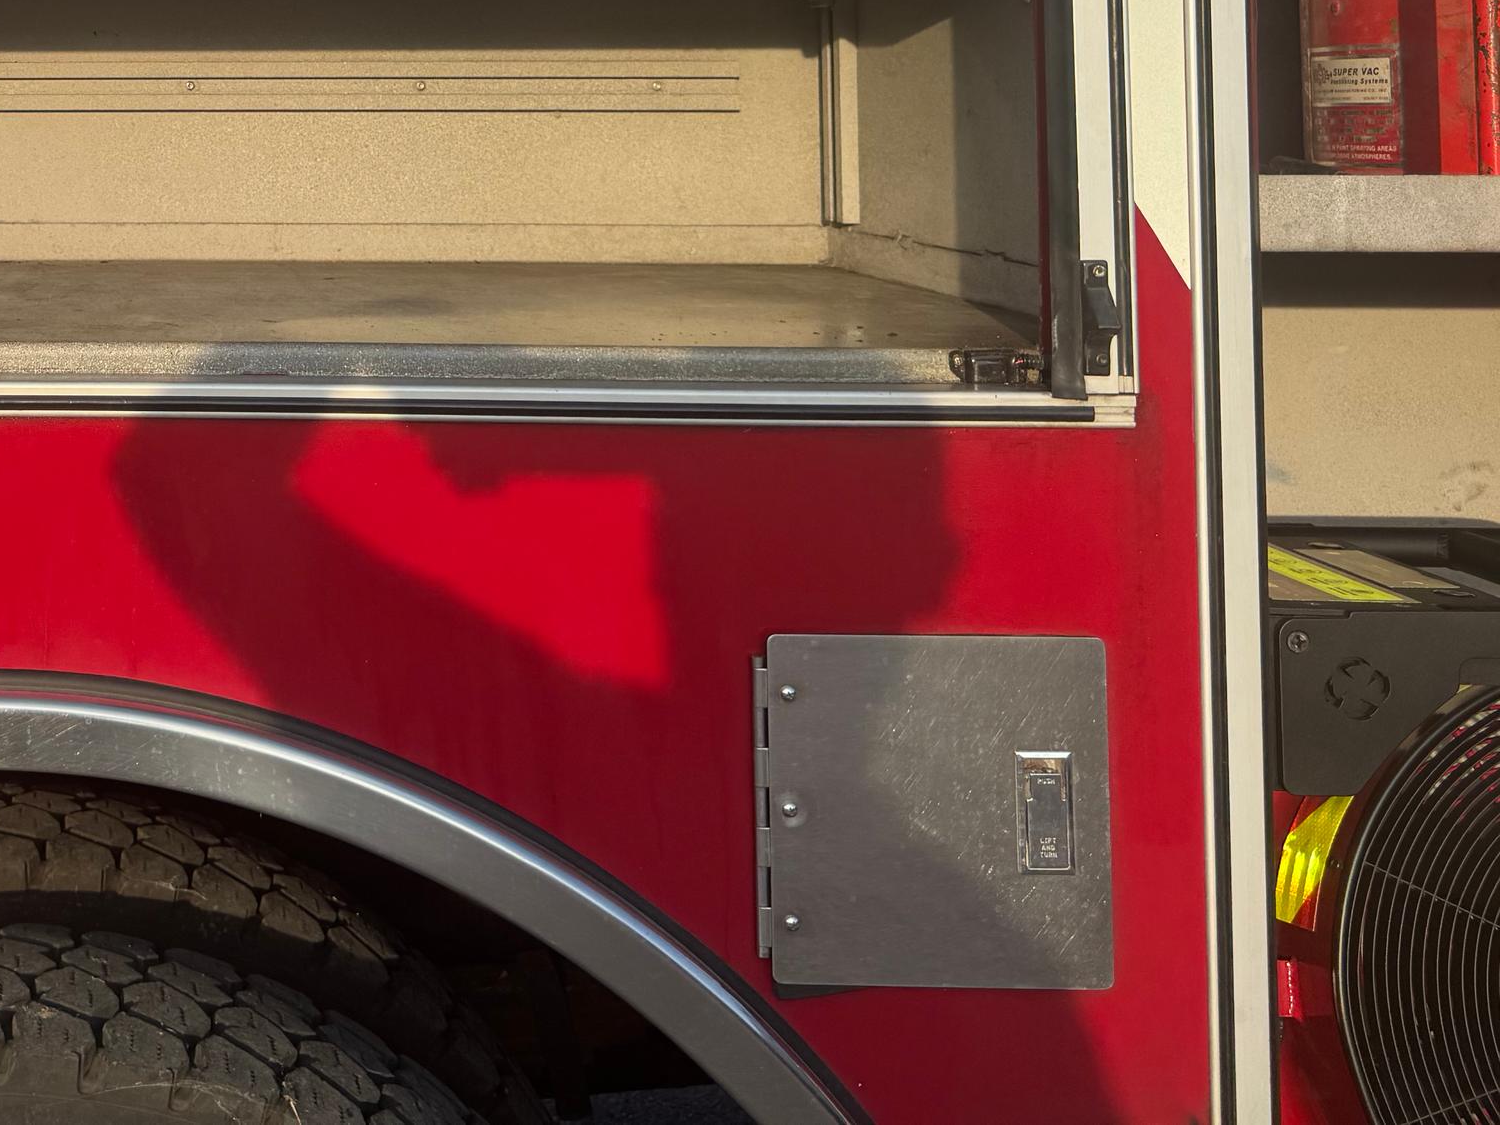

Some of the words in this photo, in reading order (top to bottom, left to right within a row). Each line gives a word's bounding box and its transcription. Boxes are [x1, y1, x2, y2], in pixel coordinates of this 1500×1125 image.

[1332, 68, 1358, 76] SUPER
[1361, 67, 1380, 76] VAC
[1040, 851, 1058, 859] TURN
